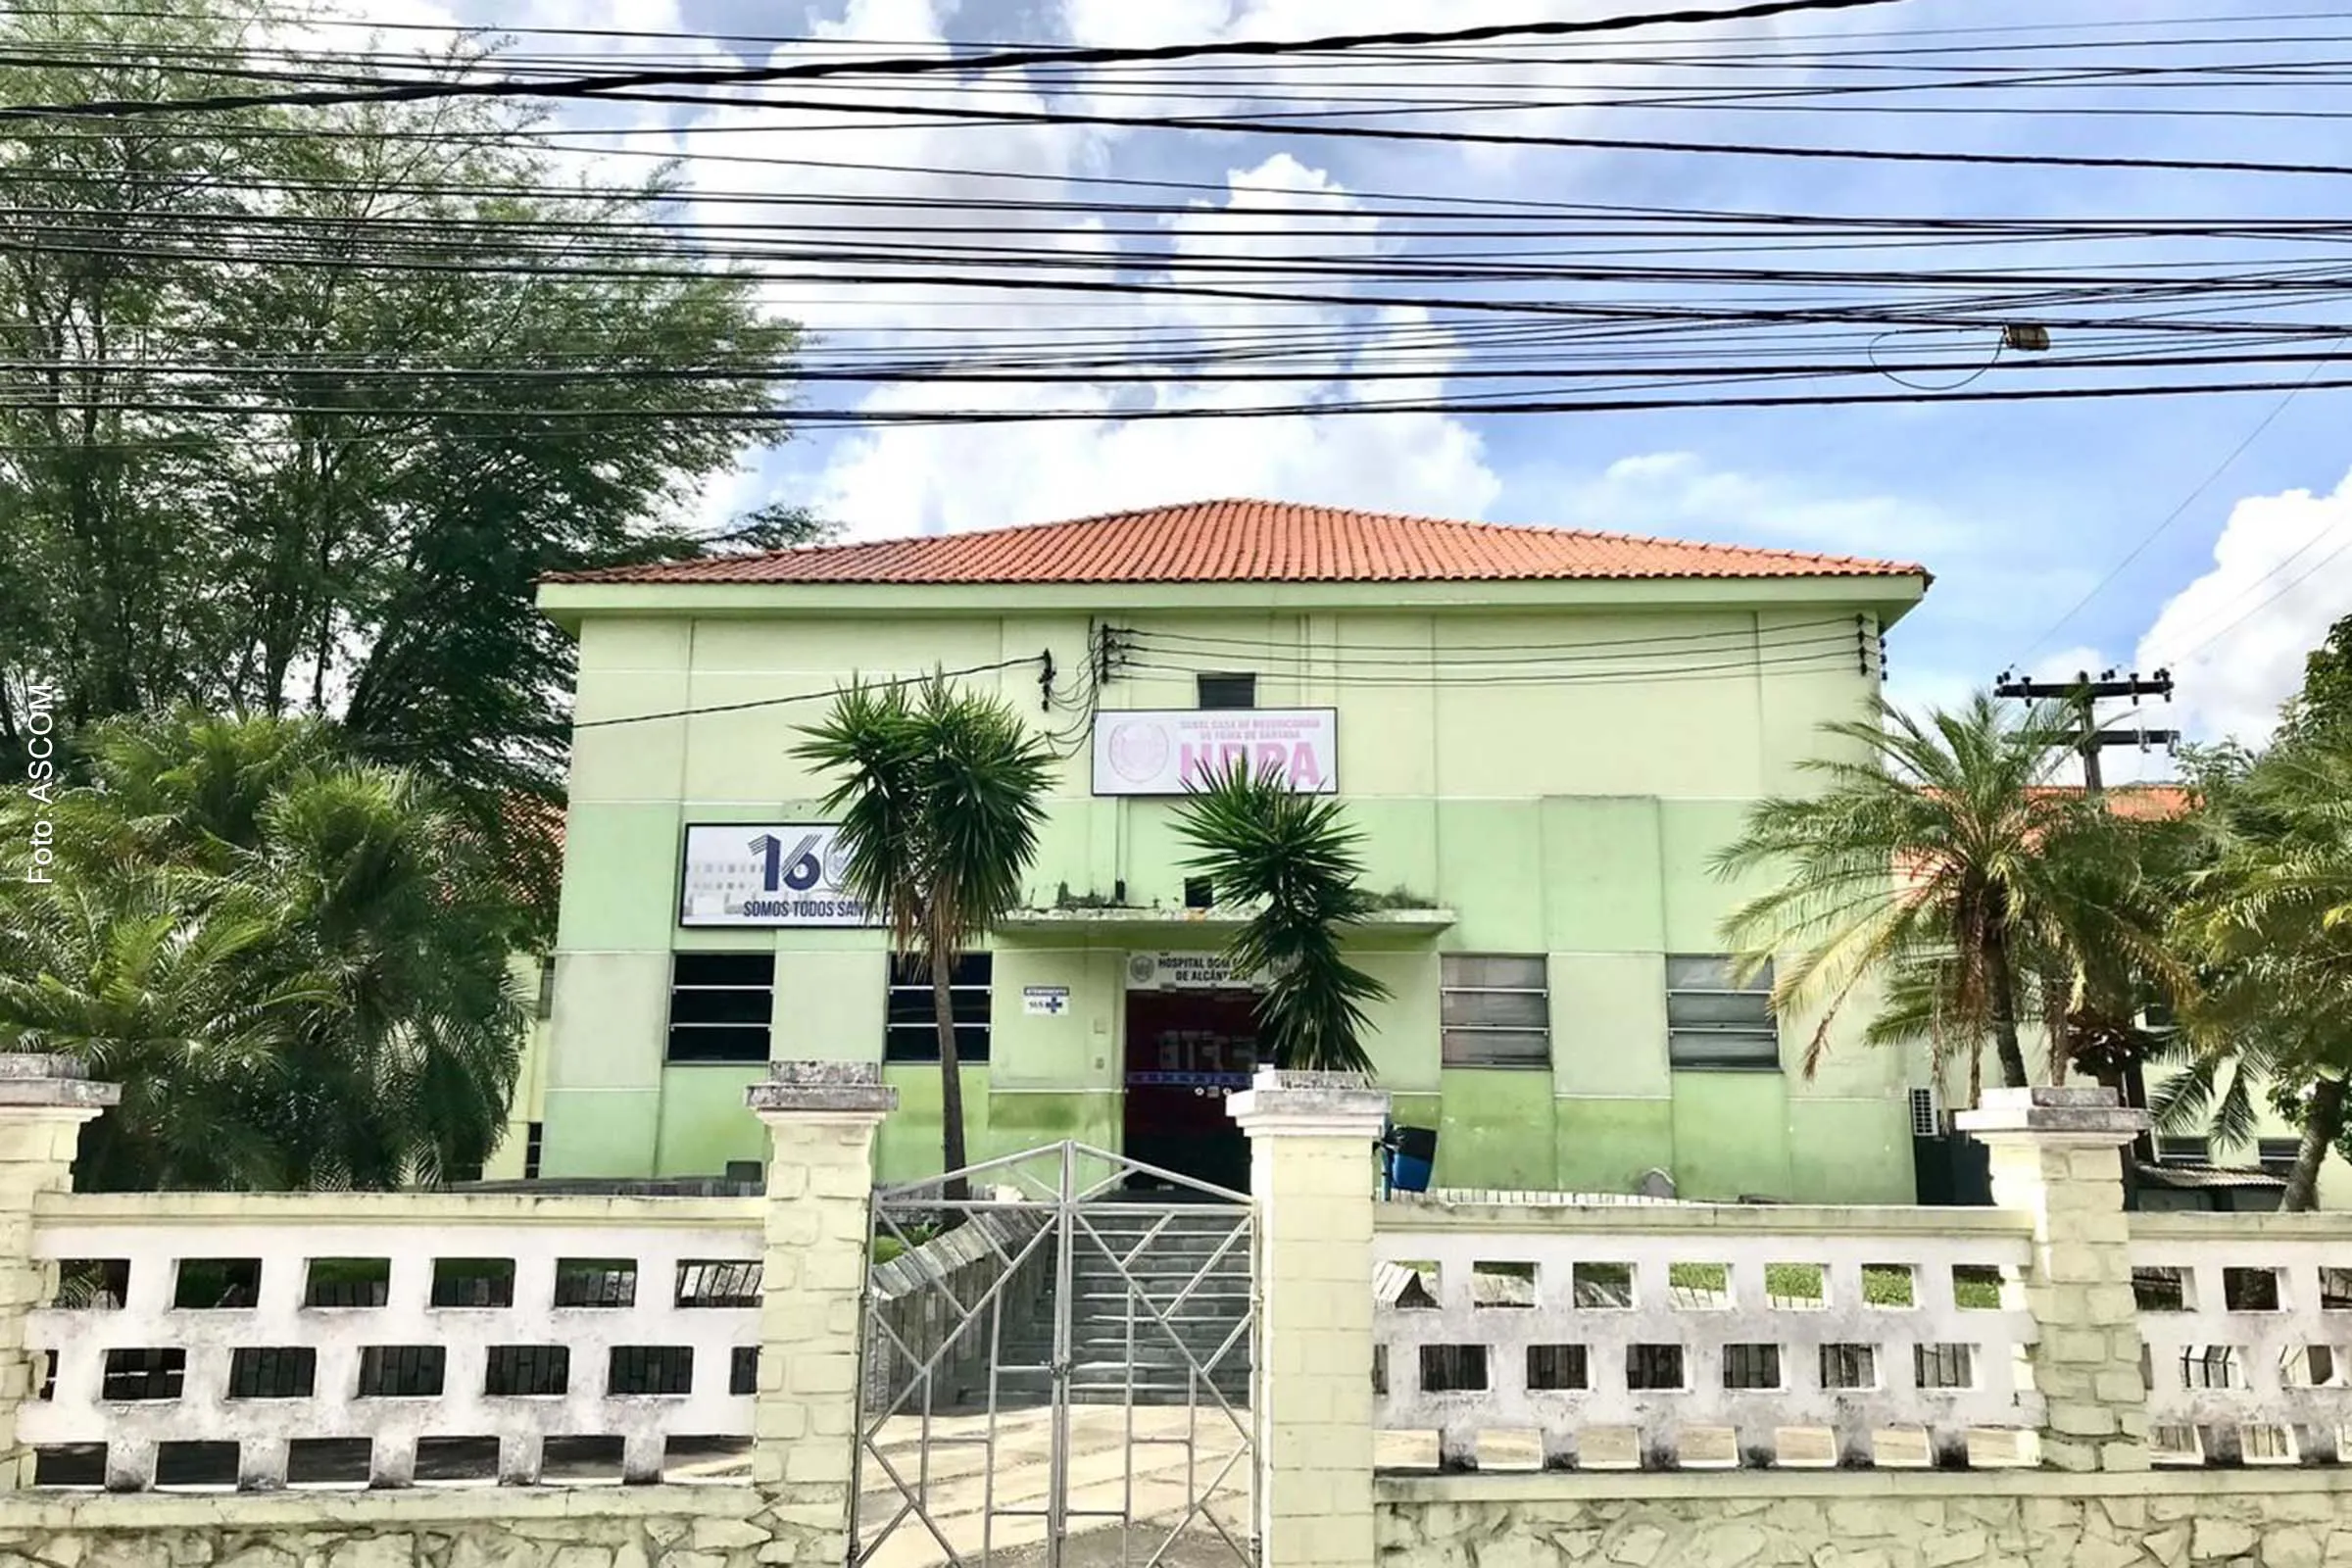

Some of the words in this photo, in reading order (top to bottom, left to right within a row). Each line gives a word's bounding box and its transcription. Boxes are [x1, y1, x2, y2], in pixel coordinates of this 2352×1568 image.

[743, 901, 790, 917] SOMOS
[792, 901, 836, 917] TODOS
[1157, 956, 1204, 968] HOSPITAL
[1175, 970, 1188, 981] DE
